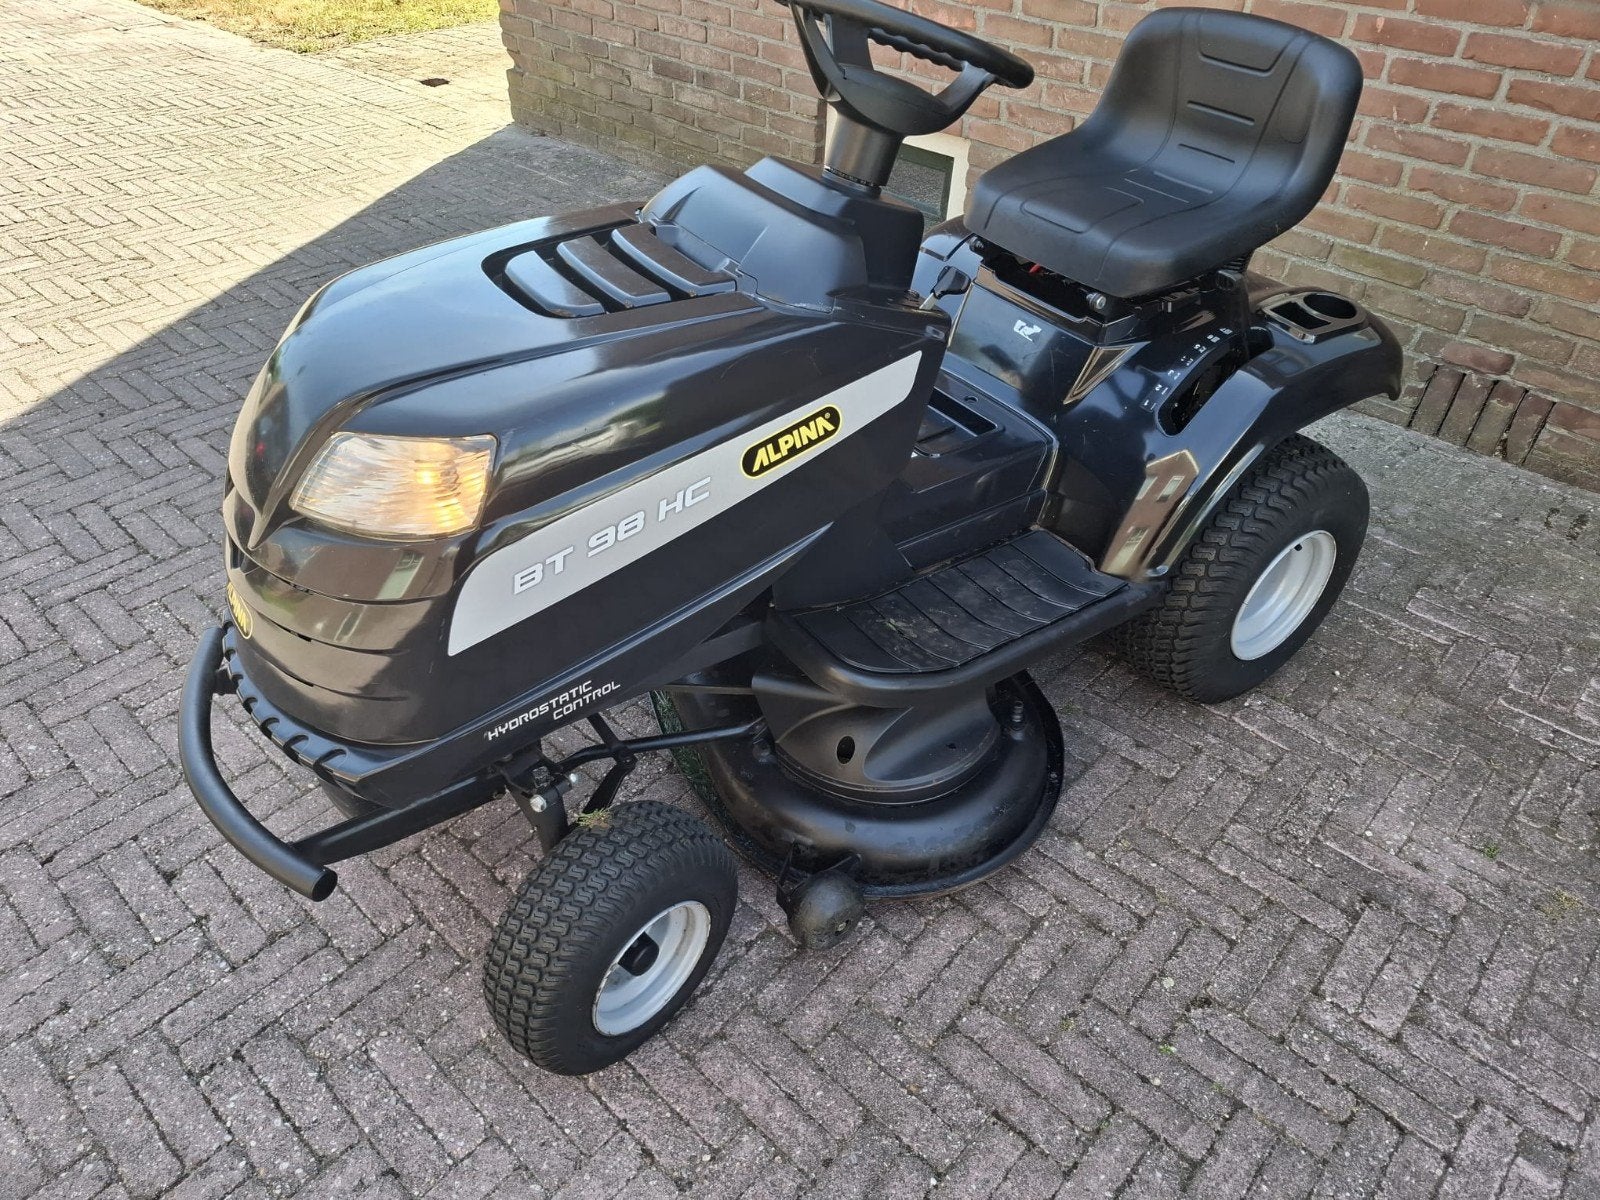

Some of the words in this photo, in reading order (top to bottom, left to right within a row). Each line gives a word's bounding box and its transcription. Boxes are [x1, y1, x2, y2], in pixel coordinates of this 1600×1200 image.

[752, 415, 836, 473] ALPINA
[513, 545, 575, 595] BT
[586, 510, 646, 558] 98
[657, 476, 712, 522] HC
[486, 680, 593, 741] HYDROSTATIC
[552, 681, 621, 720] CONTROL
